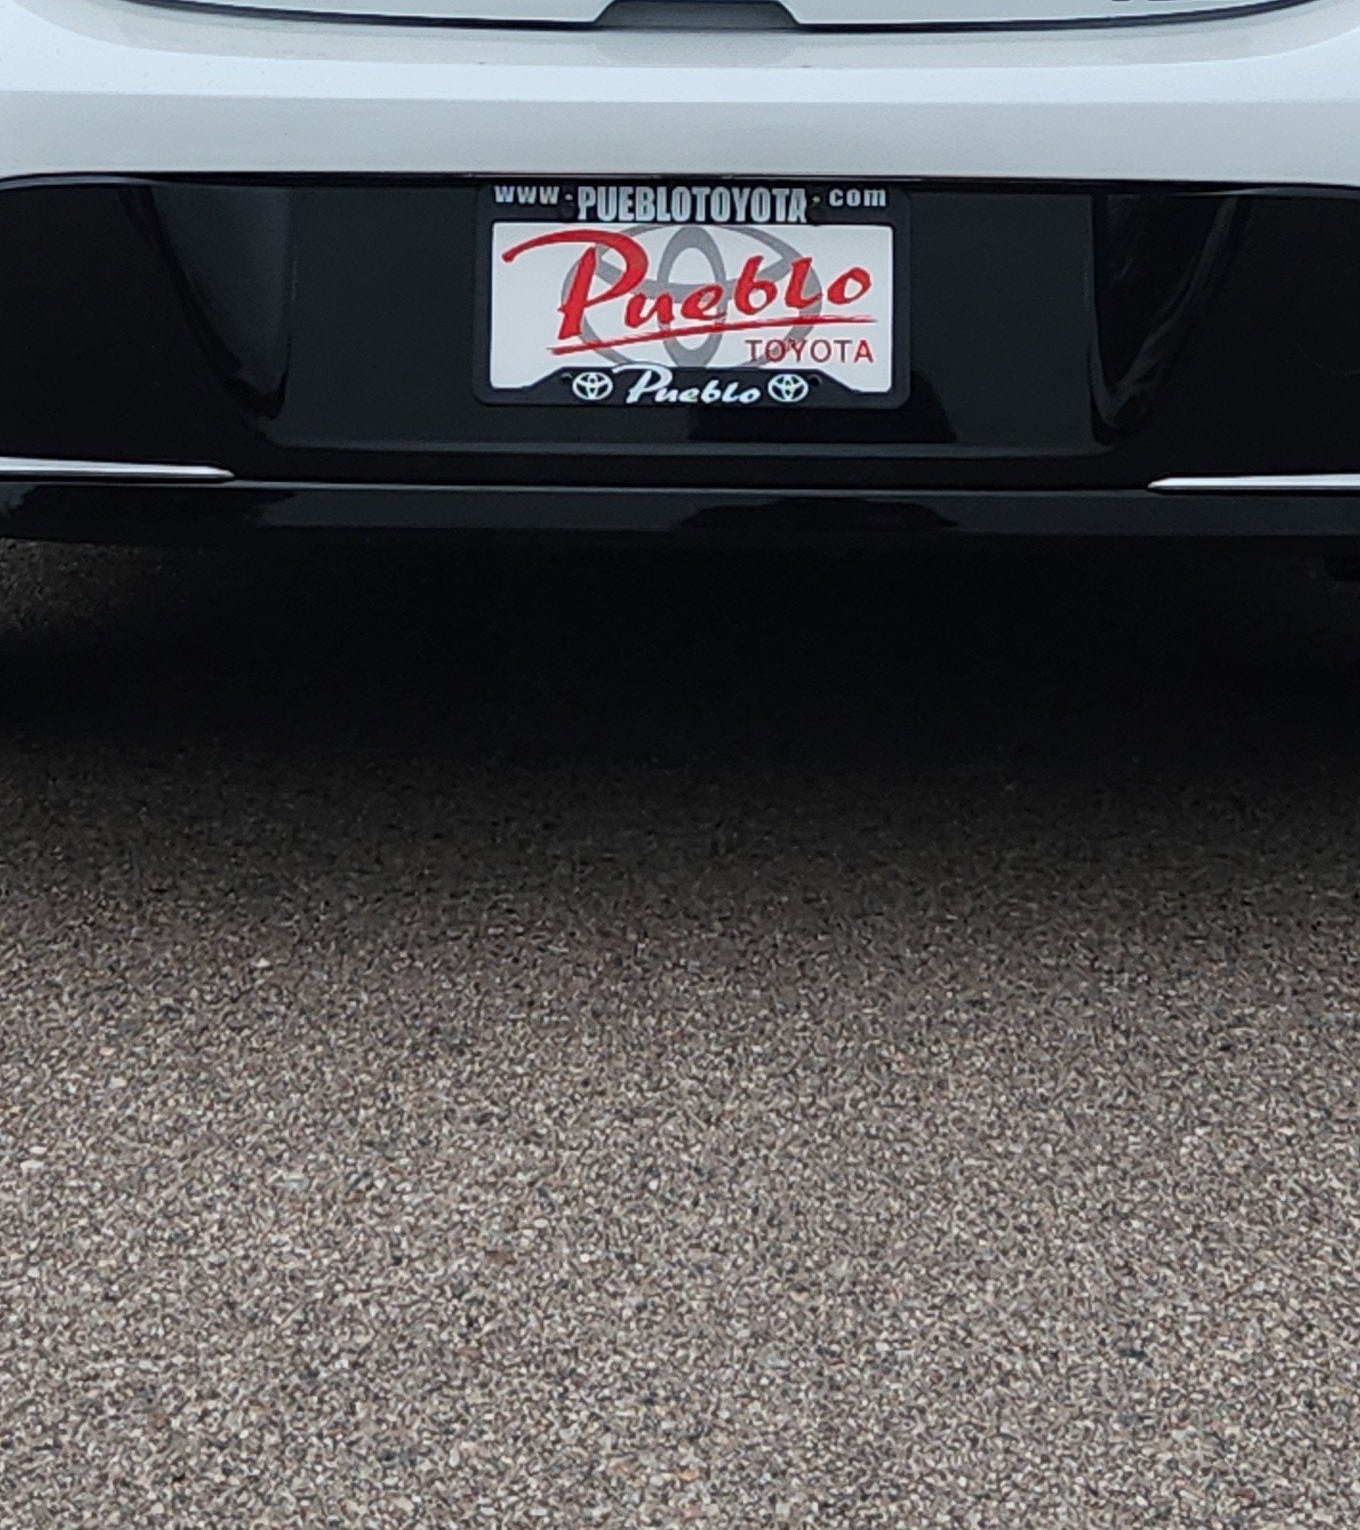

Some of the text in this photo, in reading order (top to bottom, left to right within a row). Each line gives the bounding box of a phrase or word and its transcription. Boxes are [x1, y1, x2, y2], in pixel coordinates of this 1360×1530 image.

[501, 229, 872, 340] Pueblo
[744, 338, 874, 364] TOYOTA
[612, 363, 762, 405] Pueblo
